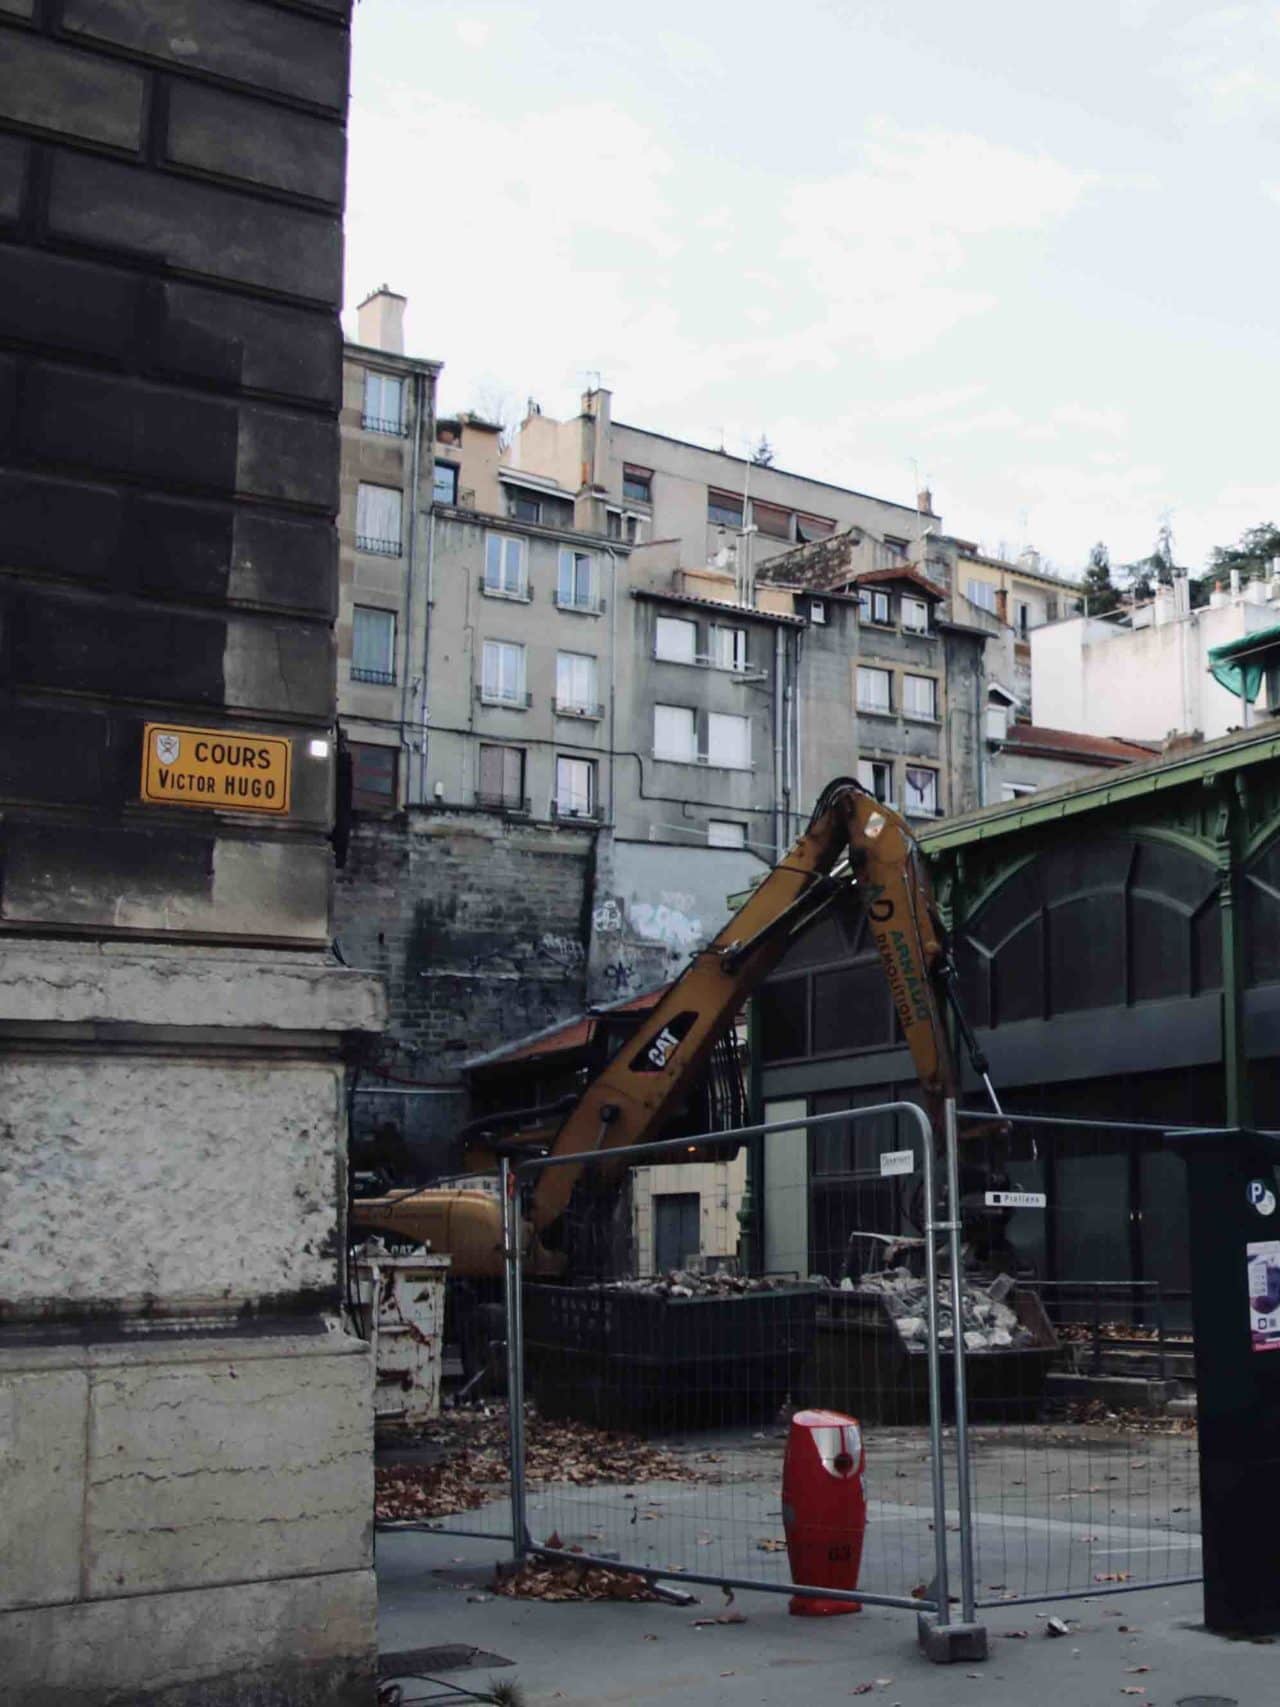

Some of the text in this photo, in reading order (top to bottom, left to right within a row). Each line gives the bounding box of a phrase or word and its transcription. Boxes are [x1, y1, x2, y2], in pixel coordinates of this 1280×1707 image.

[194, 742, 271, 770] COURS
[158, 768, 276, 799] VICTOR HUGO
[648, 1027, 680, 1067] CAT
